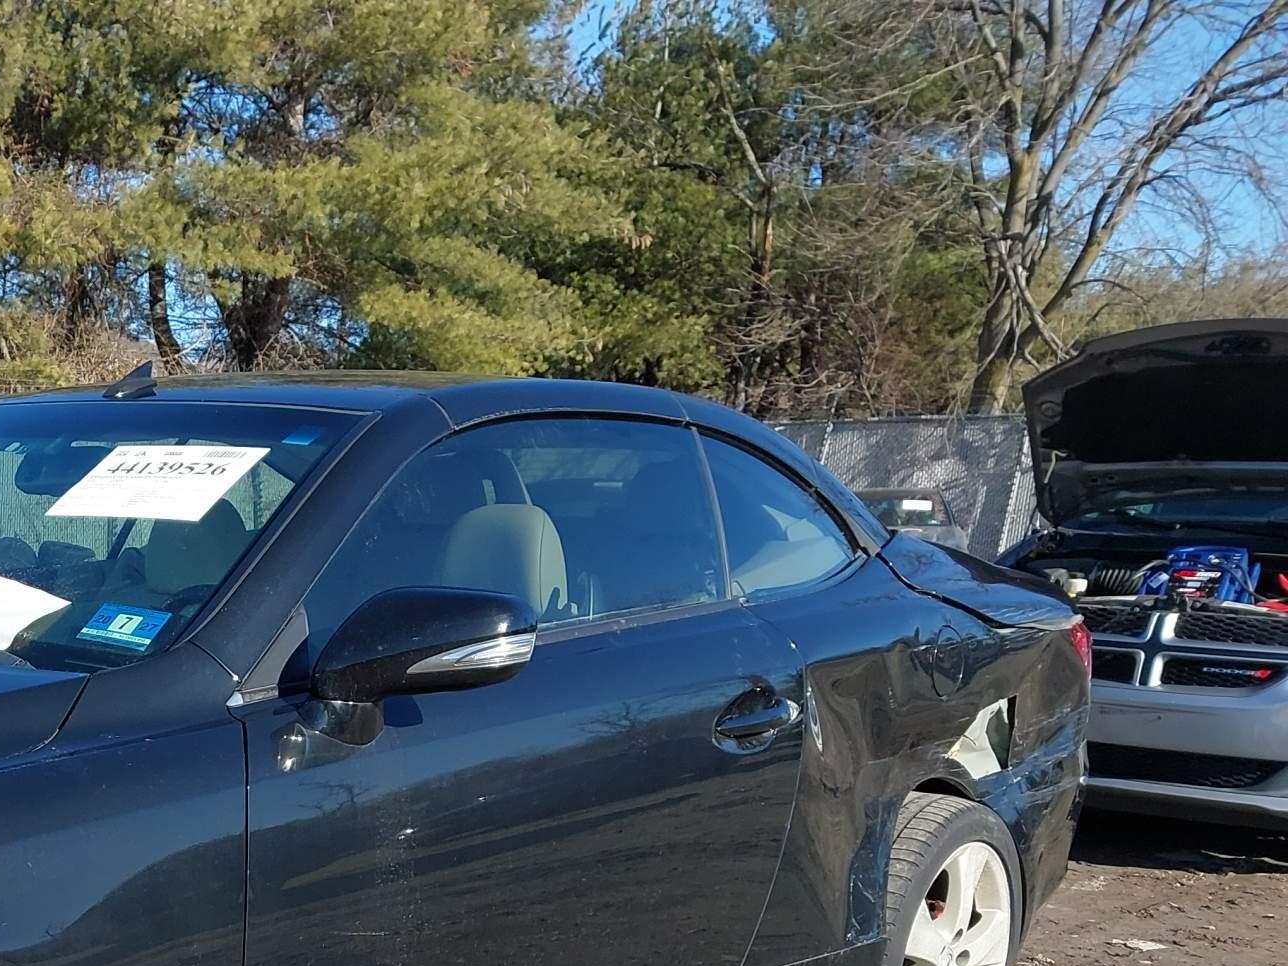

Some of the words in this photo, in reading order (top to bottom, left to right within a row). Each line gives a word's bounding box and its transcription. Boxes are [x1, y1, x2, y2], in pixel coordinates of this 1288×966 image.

[106, 461, 229, 476] 44139526
[95, 614, 112, 624] 20
[118, 616, 134, 630] 7
[138, 623, 160, 633] 27
